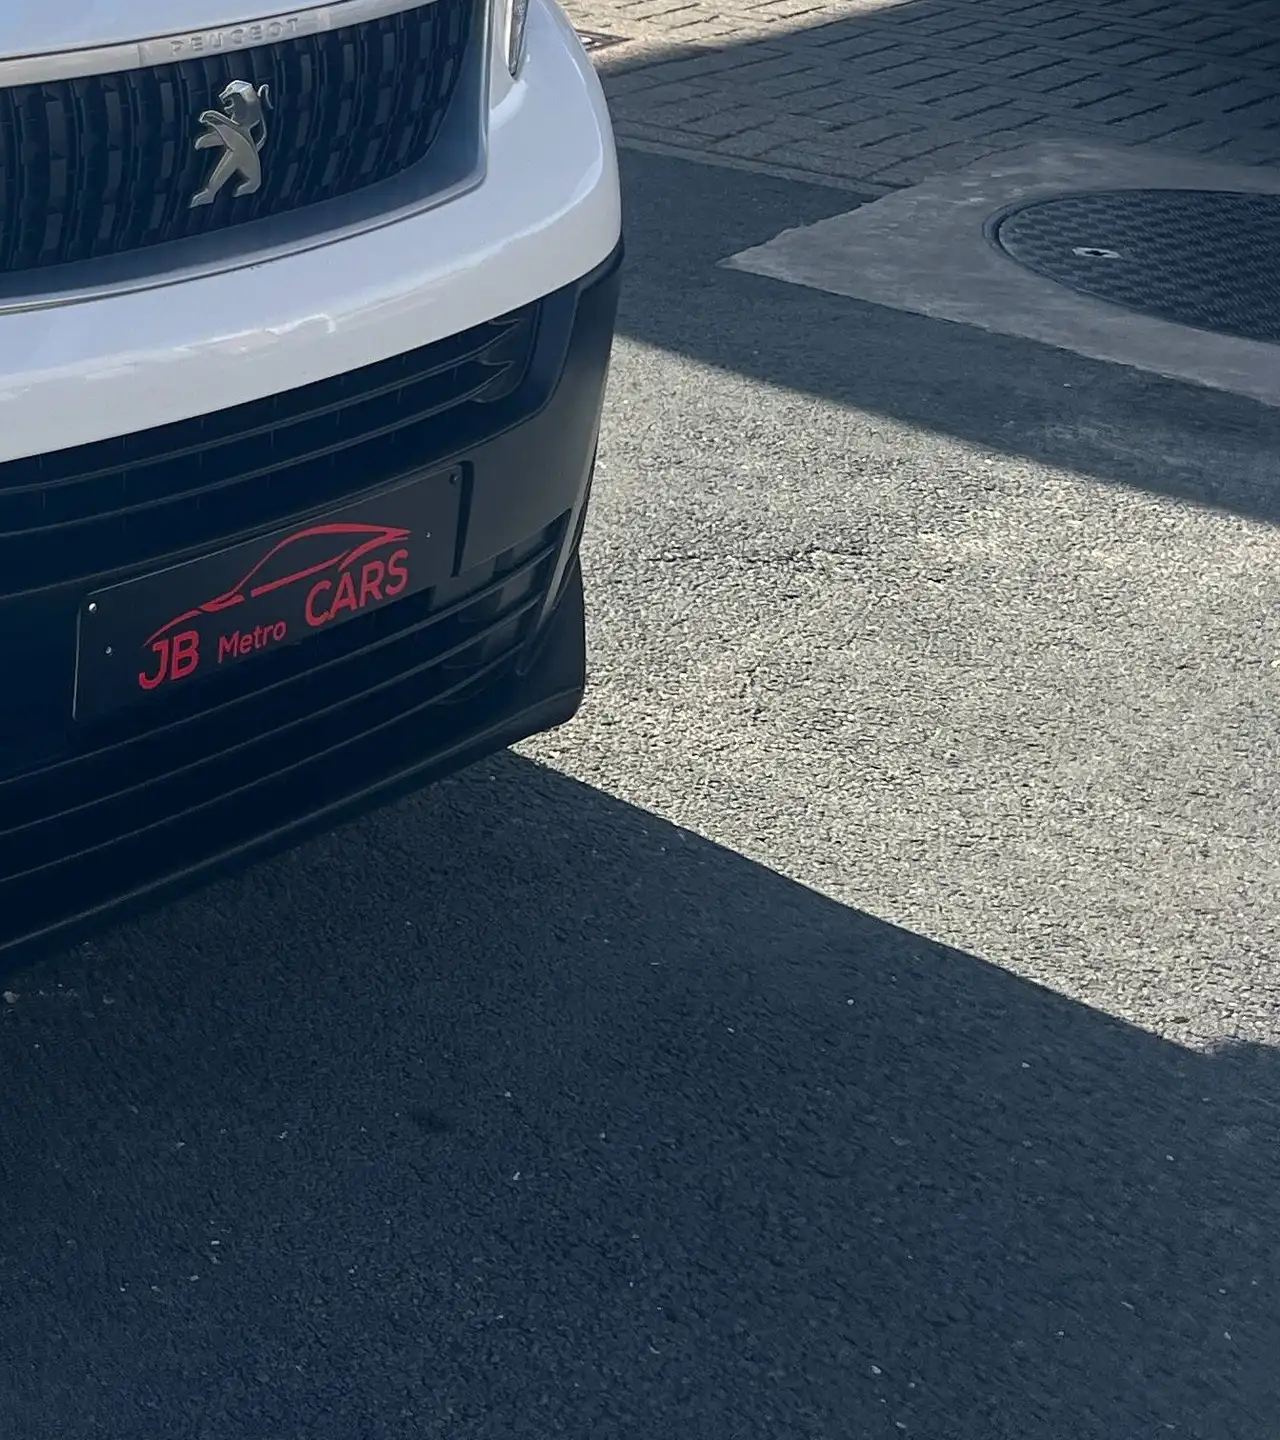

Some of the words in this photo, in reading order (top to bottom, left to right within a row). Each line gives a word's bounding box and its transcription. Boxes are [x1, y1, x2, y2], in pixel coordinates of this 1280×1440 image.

[170, 17, 298, 56] PEUGEOT
[139, 630, 200, 690] JB
[218, 621, 287, 663] Metro
[304, 549, 409, 627] CARS
